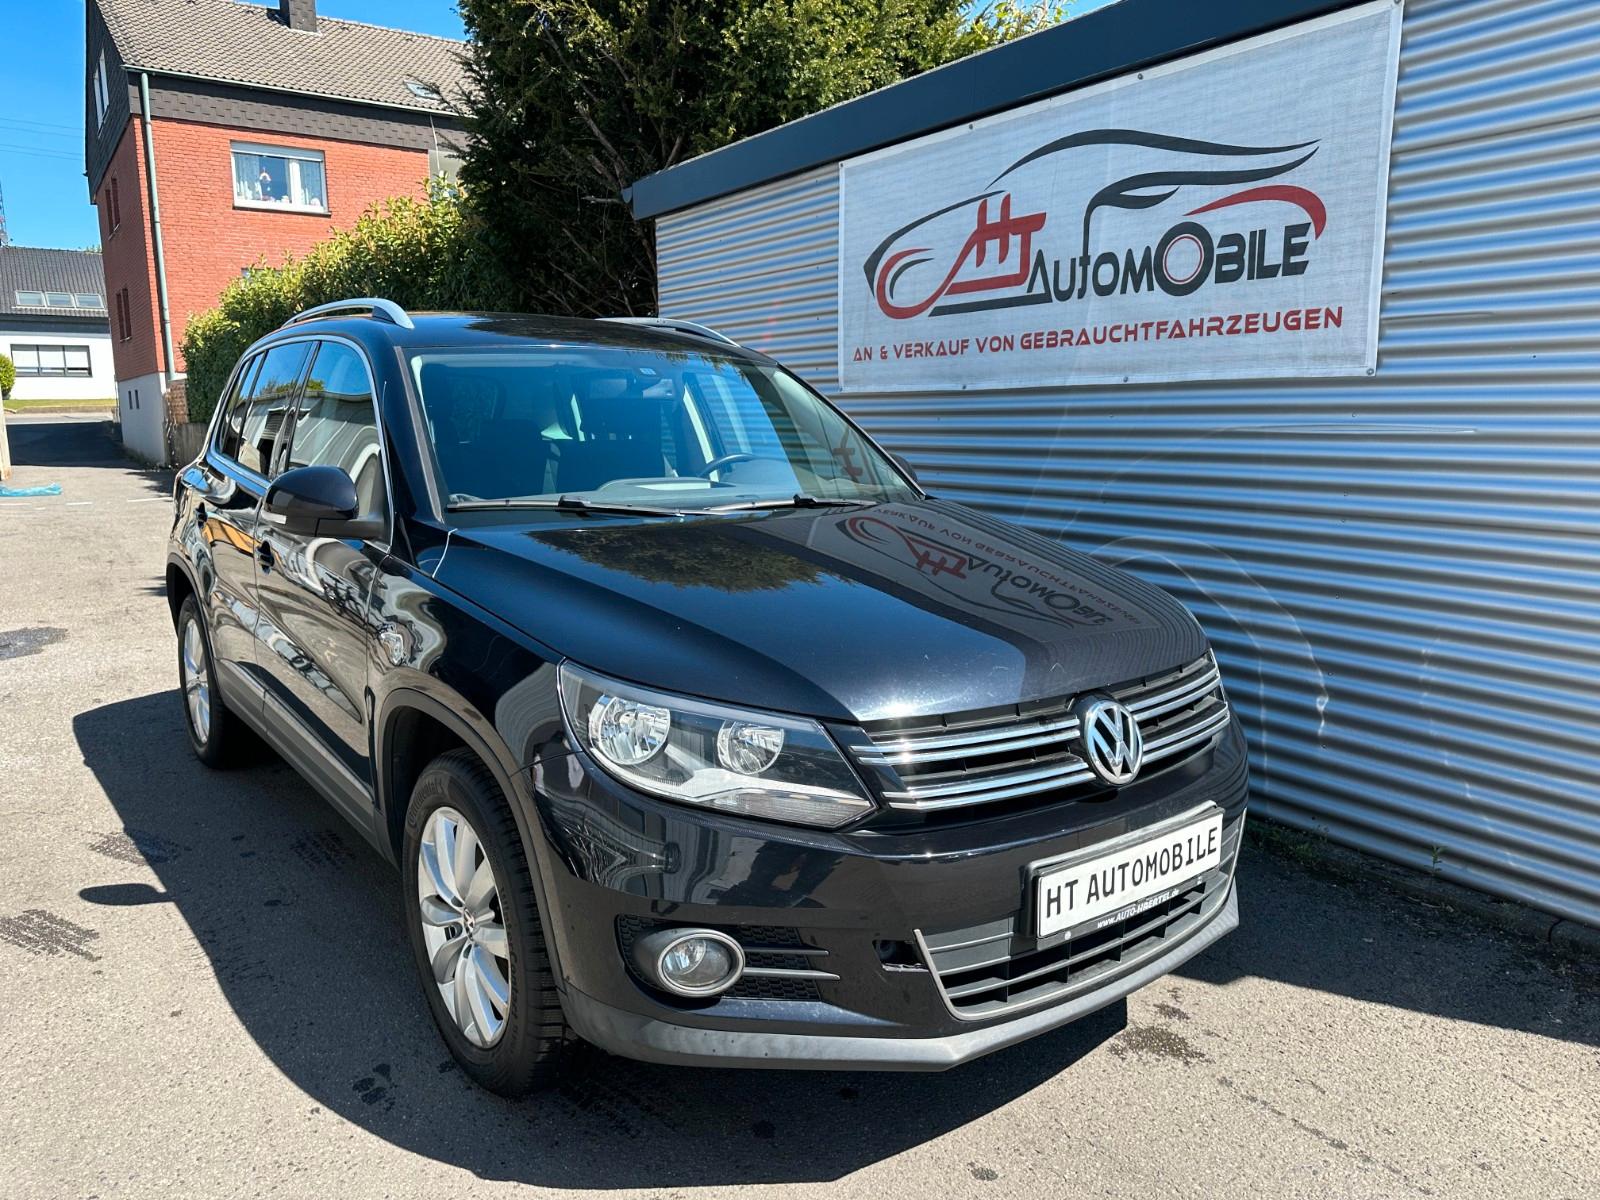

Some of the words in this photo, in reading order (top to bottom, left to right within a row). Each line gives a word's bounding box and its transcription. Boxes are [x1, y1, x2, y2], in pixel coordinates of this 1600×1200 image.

[974, 192, 1047, 288] HT
[1026, 221, 1312, 303] AUTOMOBILE
[853, 346, 873, 362] AN
[880, 346, 889, 360] &
[893, 338, 970, 360] VERKAUF
[975, 334, 1014, 354] VON
[1020, 306, 1343, 350] GEBRAUCHTFAHRZEUGEN
[1046, 878, 1079, 919] HT
[1086, 827, 1218, 905] AUTOMOBILE
